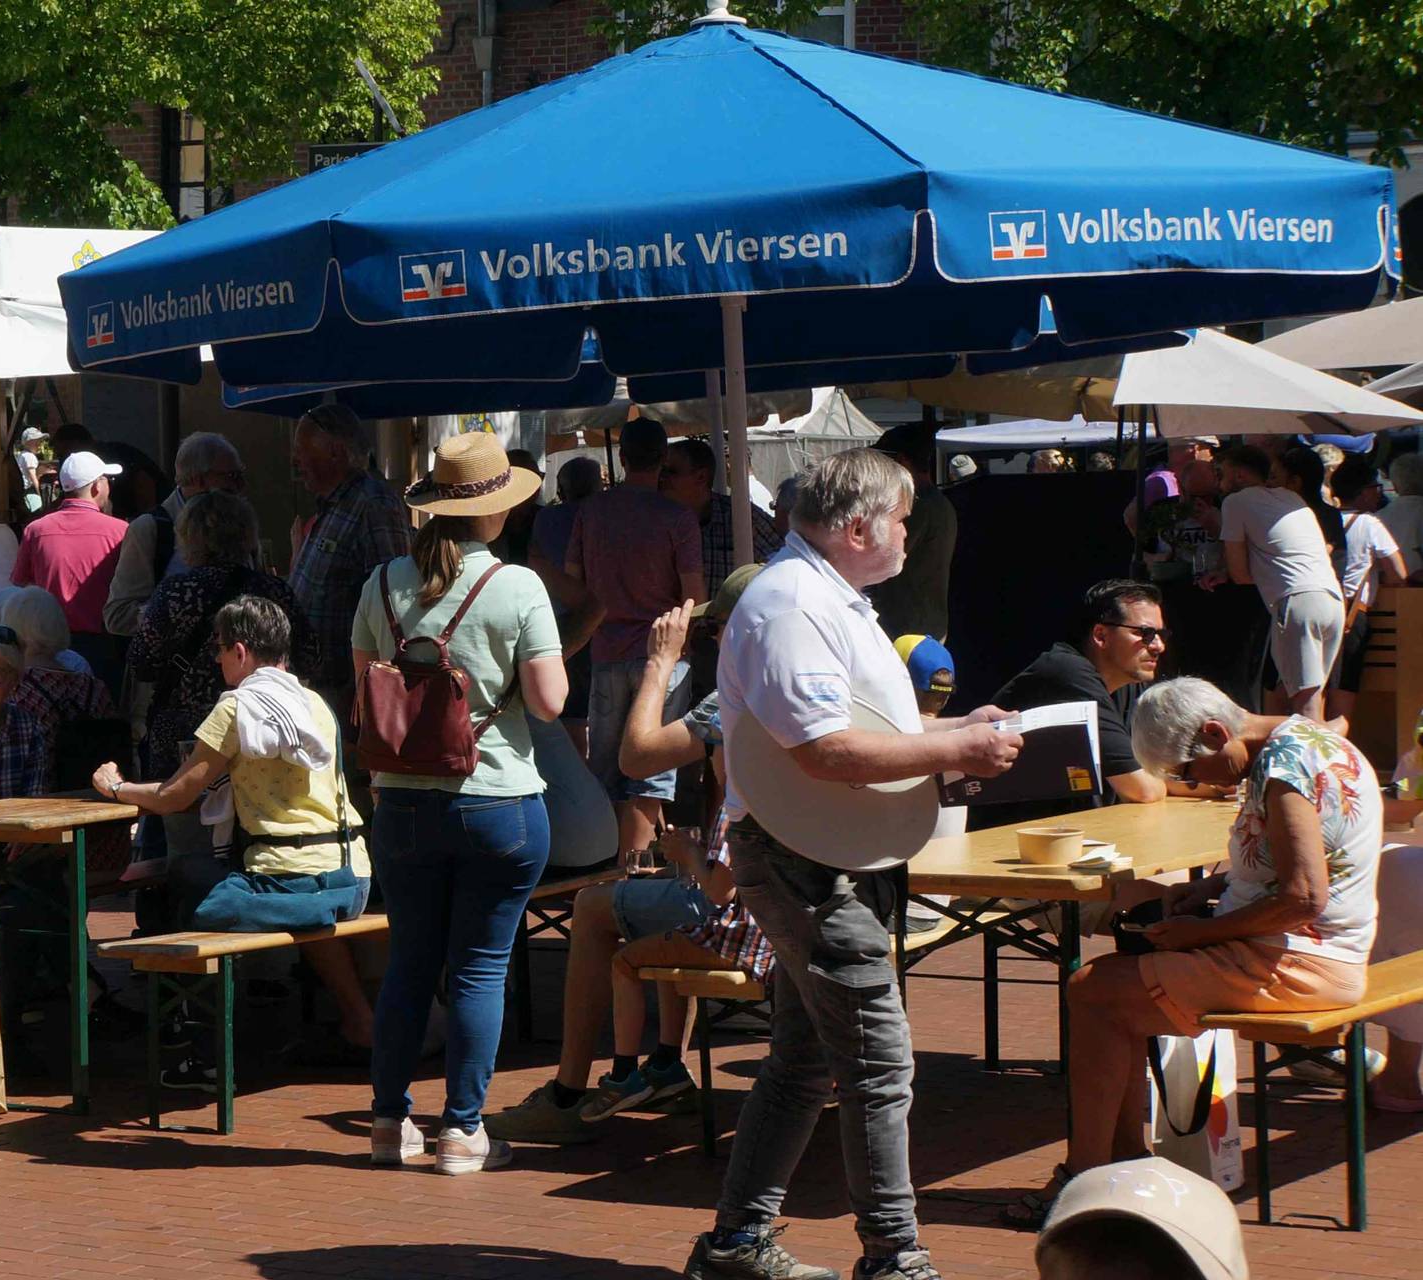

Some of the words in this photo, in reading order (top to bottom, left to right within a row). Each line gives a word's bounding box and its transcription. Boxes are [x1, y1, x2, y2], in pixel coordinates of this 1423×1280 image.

[1057, 207, 1222, 244] Volksbank
[1227, 208, 1333, 243] Viersen
[479, 232, 686, 281] Volksbank
[695, 229, 848, 263] Viersen
[119, 283, 213, 329] Volksbank
[217, 280, 295, 313] Viersen
